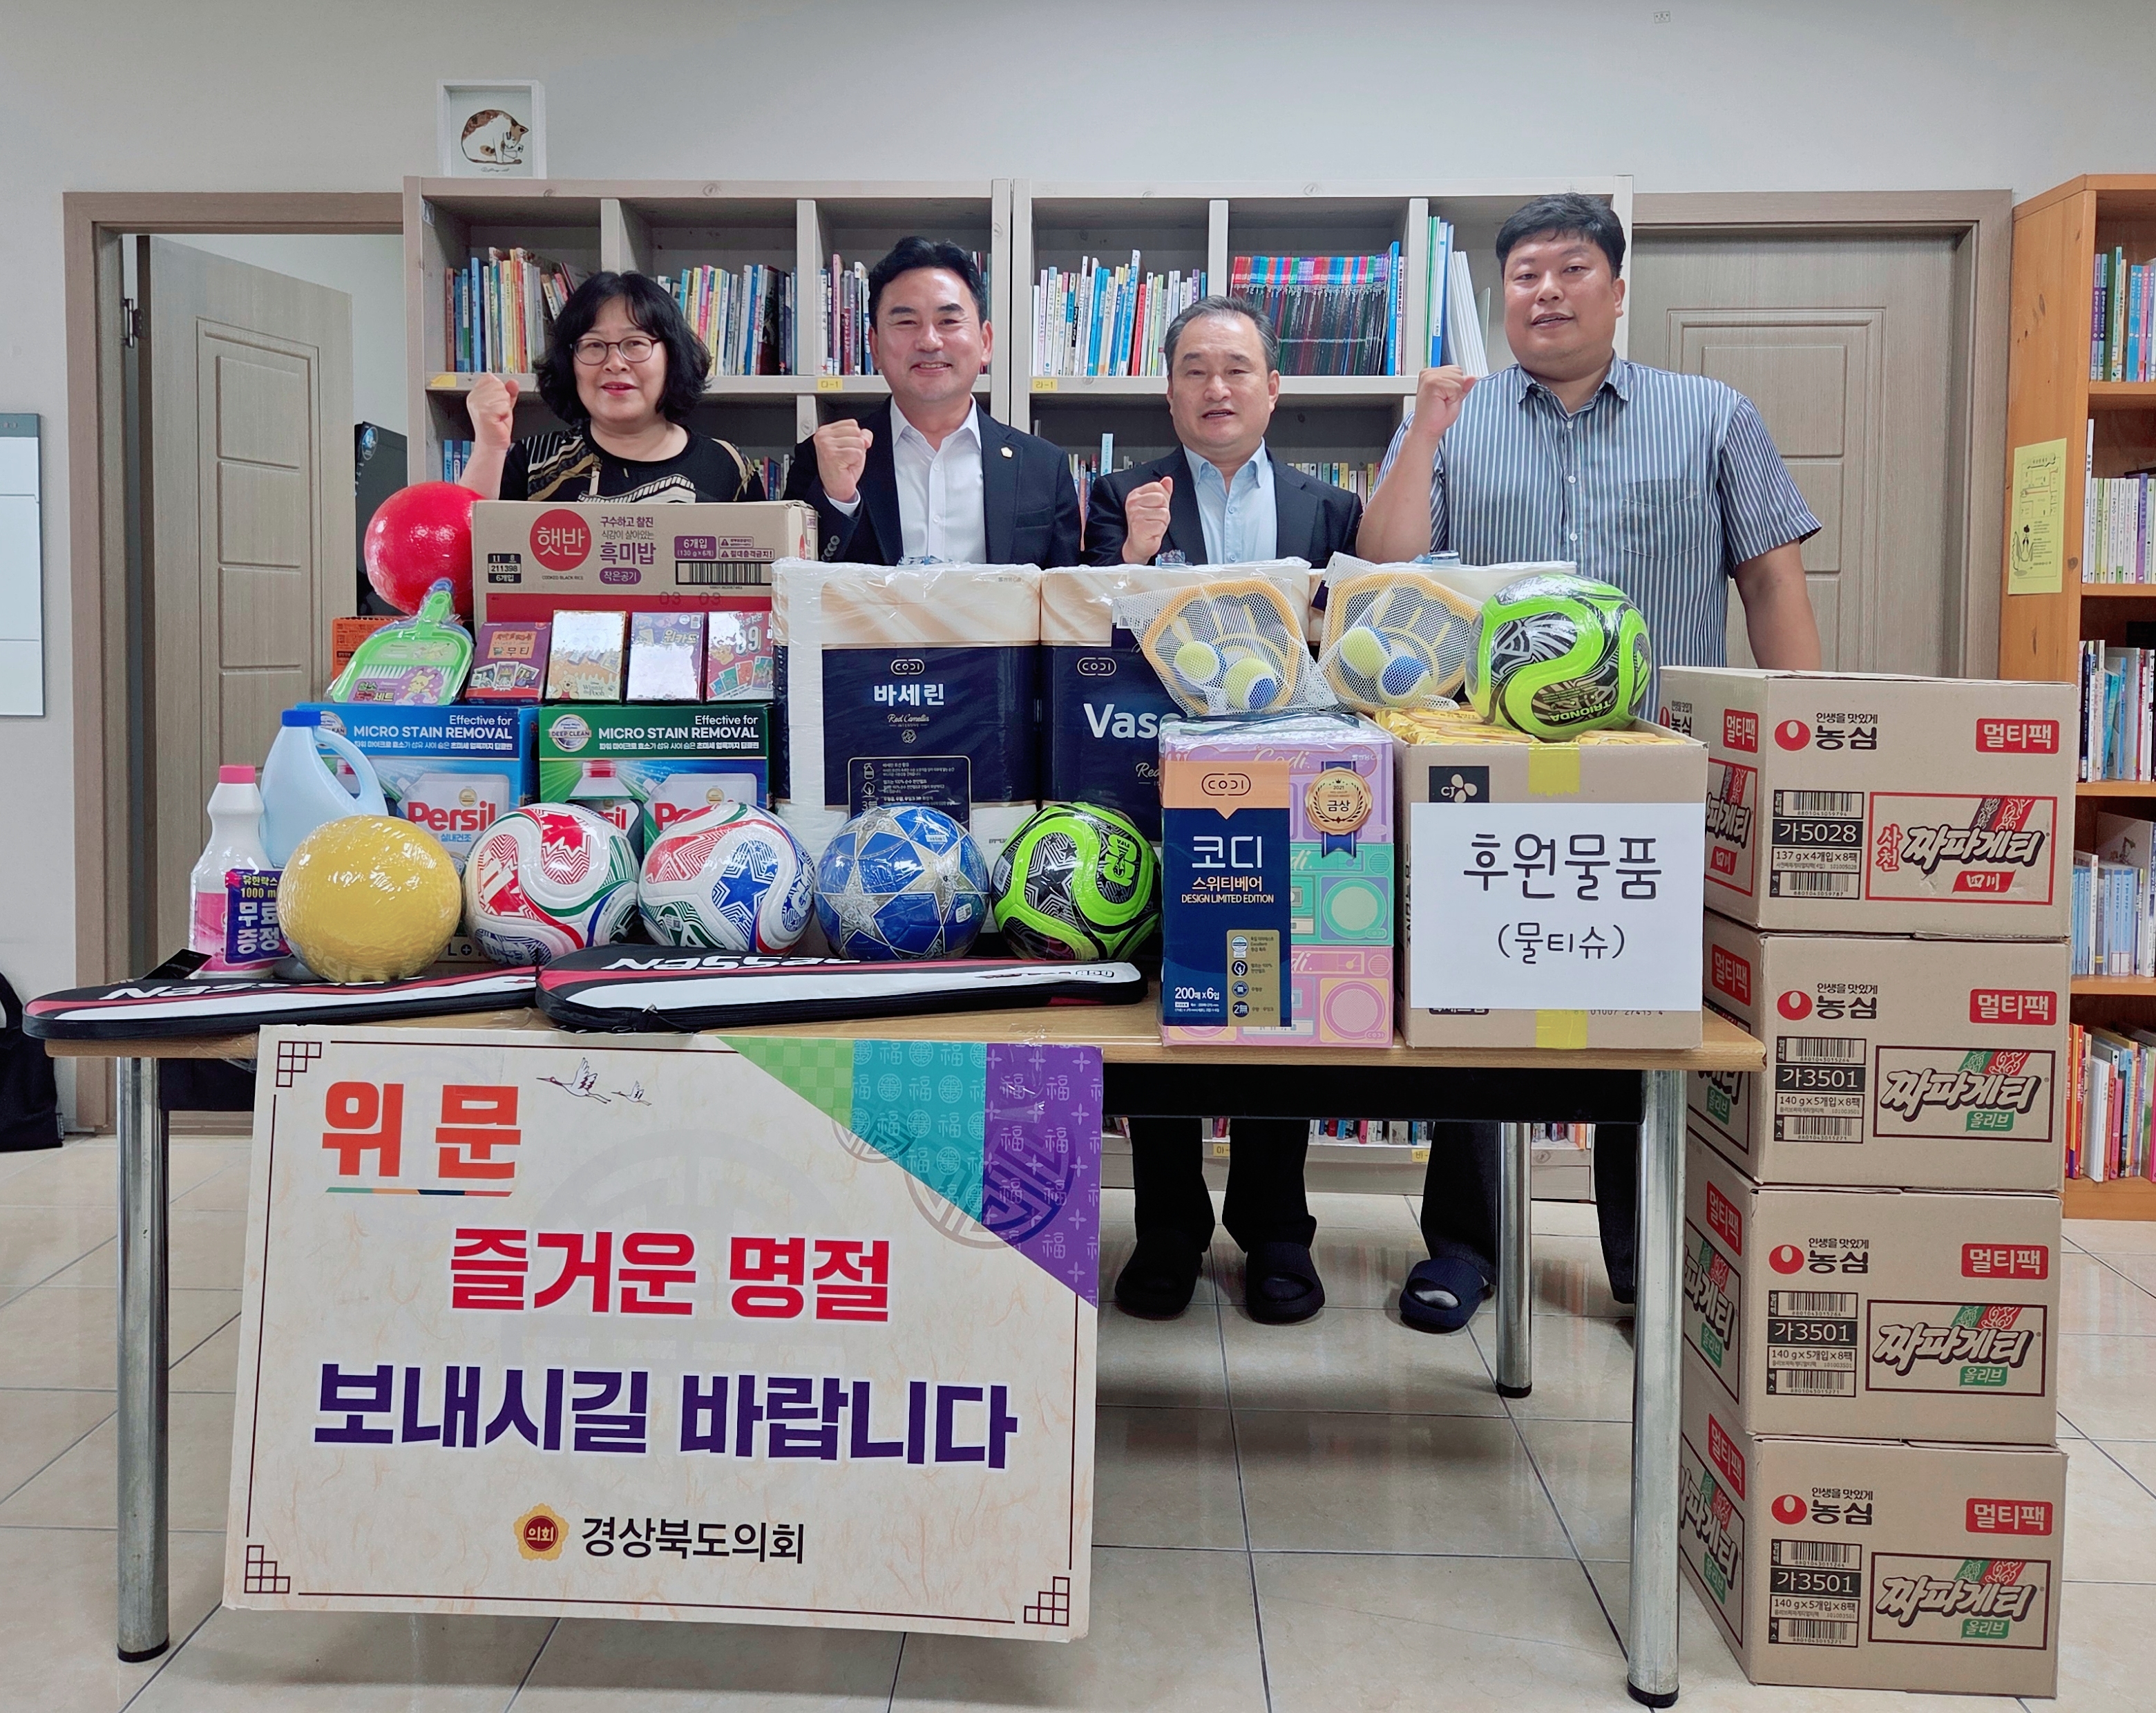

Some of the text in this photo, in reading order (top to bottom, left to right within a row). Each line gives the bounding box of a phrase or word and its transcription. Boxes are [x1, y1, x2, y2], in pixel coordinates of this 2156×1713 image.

[600, 516, 654, 528] 구수하고 찰진
[537, 526, 586, 556] 햇반
[602, 530, 655, 540] 식감이 살아있는
[683, 538, 707, 549] 6개입
[600, 542, 656, 565] 흑미밥
[604, 571, 637, 583] 작은공기
[659, 591, 721, 605] 03 03
[874, 683, 944, 706] 바세린
[449, 714, 513, 726] Effective for
[695, 715, 759, 726] Effective for
[1549, 700, 1611, 722] TRIONDA
[1816, 712, 1878, 725] 인생을 맛있게
[354, 726, 513, 740] MICRO STAIN REMOVAL
[598, 726, 759, 739] MICRO STAIN REMOVAL
[1726, 715, 1756, 748] 멀티팩
[1815, 725, 1878, 750] 농심
[1983, 723, 2052, 749] 멀티팩
[1208, 779, 1244, 790] CODI
[1441, 786, 1456, 798] CJ
[408, 801, 496, 831] Persil
[1327, 799, 1351, 812] 금상
[1706, 793, 1750, 849] 파게티
[440, 833, 472, 843] 실내건조
[1779, 822, 1857, 843] 가5028
[1192, 835, 1263, 869] 코디
[1776, 851, 1794, 860] 137
[1876, 824, 1901, 873] 사천
[1902, 824, 2045, 878] 짜파게티
[1463, 833, 1662, 901] 후원물품
[242, 875, 278, 887] 유한락스
[1192, 876, 1263, 892] 스위티베어
[1965, 873, 2001, 891] 四川
[240, 887, 277, 898] 1000 m
[1181, 894, 1274, 904] DESIGN LIMITED EDITION
[238, 901, 278, 927] 무료
[237, 928, 280, 954] 증정
[1498, 922, 1625, 965] (물티슈)
[1715, 952, 1748, 999] 멀티팩
[1817, 983, 1878, 994] 인생을 맛있게
[1816, 996, 1878, 1020] 농심
[1977, 994, 2049, 1021] 멀티팩
[1782, 1068, 1858, 1088] 가3501
[1780, 1096, 1797, 1105] 140
[1880, 1068, 2041, 1122] 짜파게티
[1969, 1112, 2009, 1128] 올리브
[1709, 1190, 1739, 1247] 멀티팩
[1809, 1238, 1869, 1249] 인생을 맛있게
[1808, 1251, 1869, 1274] 농심
[1969, 1248, 2041, 1274] 멀티팩
[450, 1229, 890, 1322] 즐거운 명절
[1685, 1254, 1735, 1351] 파게티
[1775, 1322, 1850, 1342] 가3501
[1772, 1350, 1789, 1359] 140
[1872, 1322, 2034, 1377] 짜파게티
[1964, 1367, 2003, 1383] 올리브
[314, 1363, 1018, 1469] 보내시길 바랍니다
[1711, 1423, 1742, 1491] 멀티팩
[1811, 1487, 1873, 1501] 인생을 맛있게
[1811, 1499, 1873, 1526] 농심
[1974, 1503, 2045, 1530] 멀티팩
[527, 1525, 555, 1542] 의회
[581, 1516, 805, 1564] 경상북도의회
[1777, 1571, 1853, 1593] 가3501
[1774, 1598, 1791, 1607] 140
[1876, 1575, 2037, 1627] 짜파게티
[1965, 1620, 2004, 1636] 올리브
